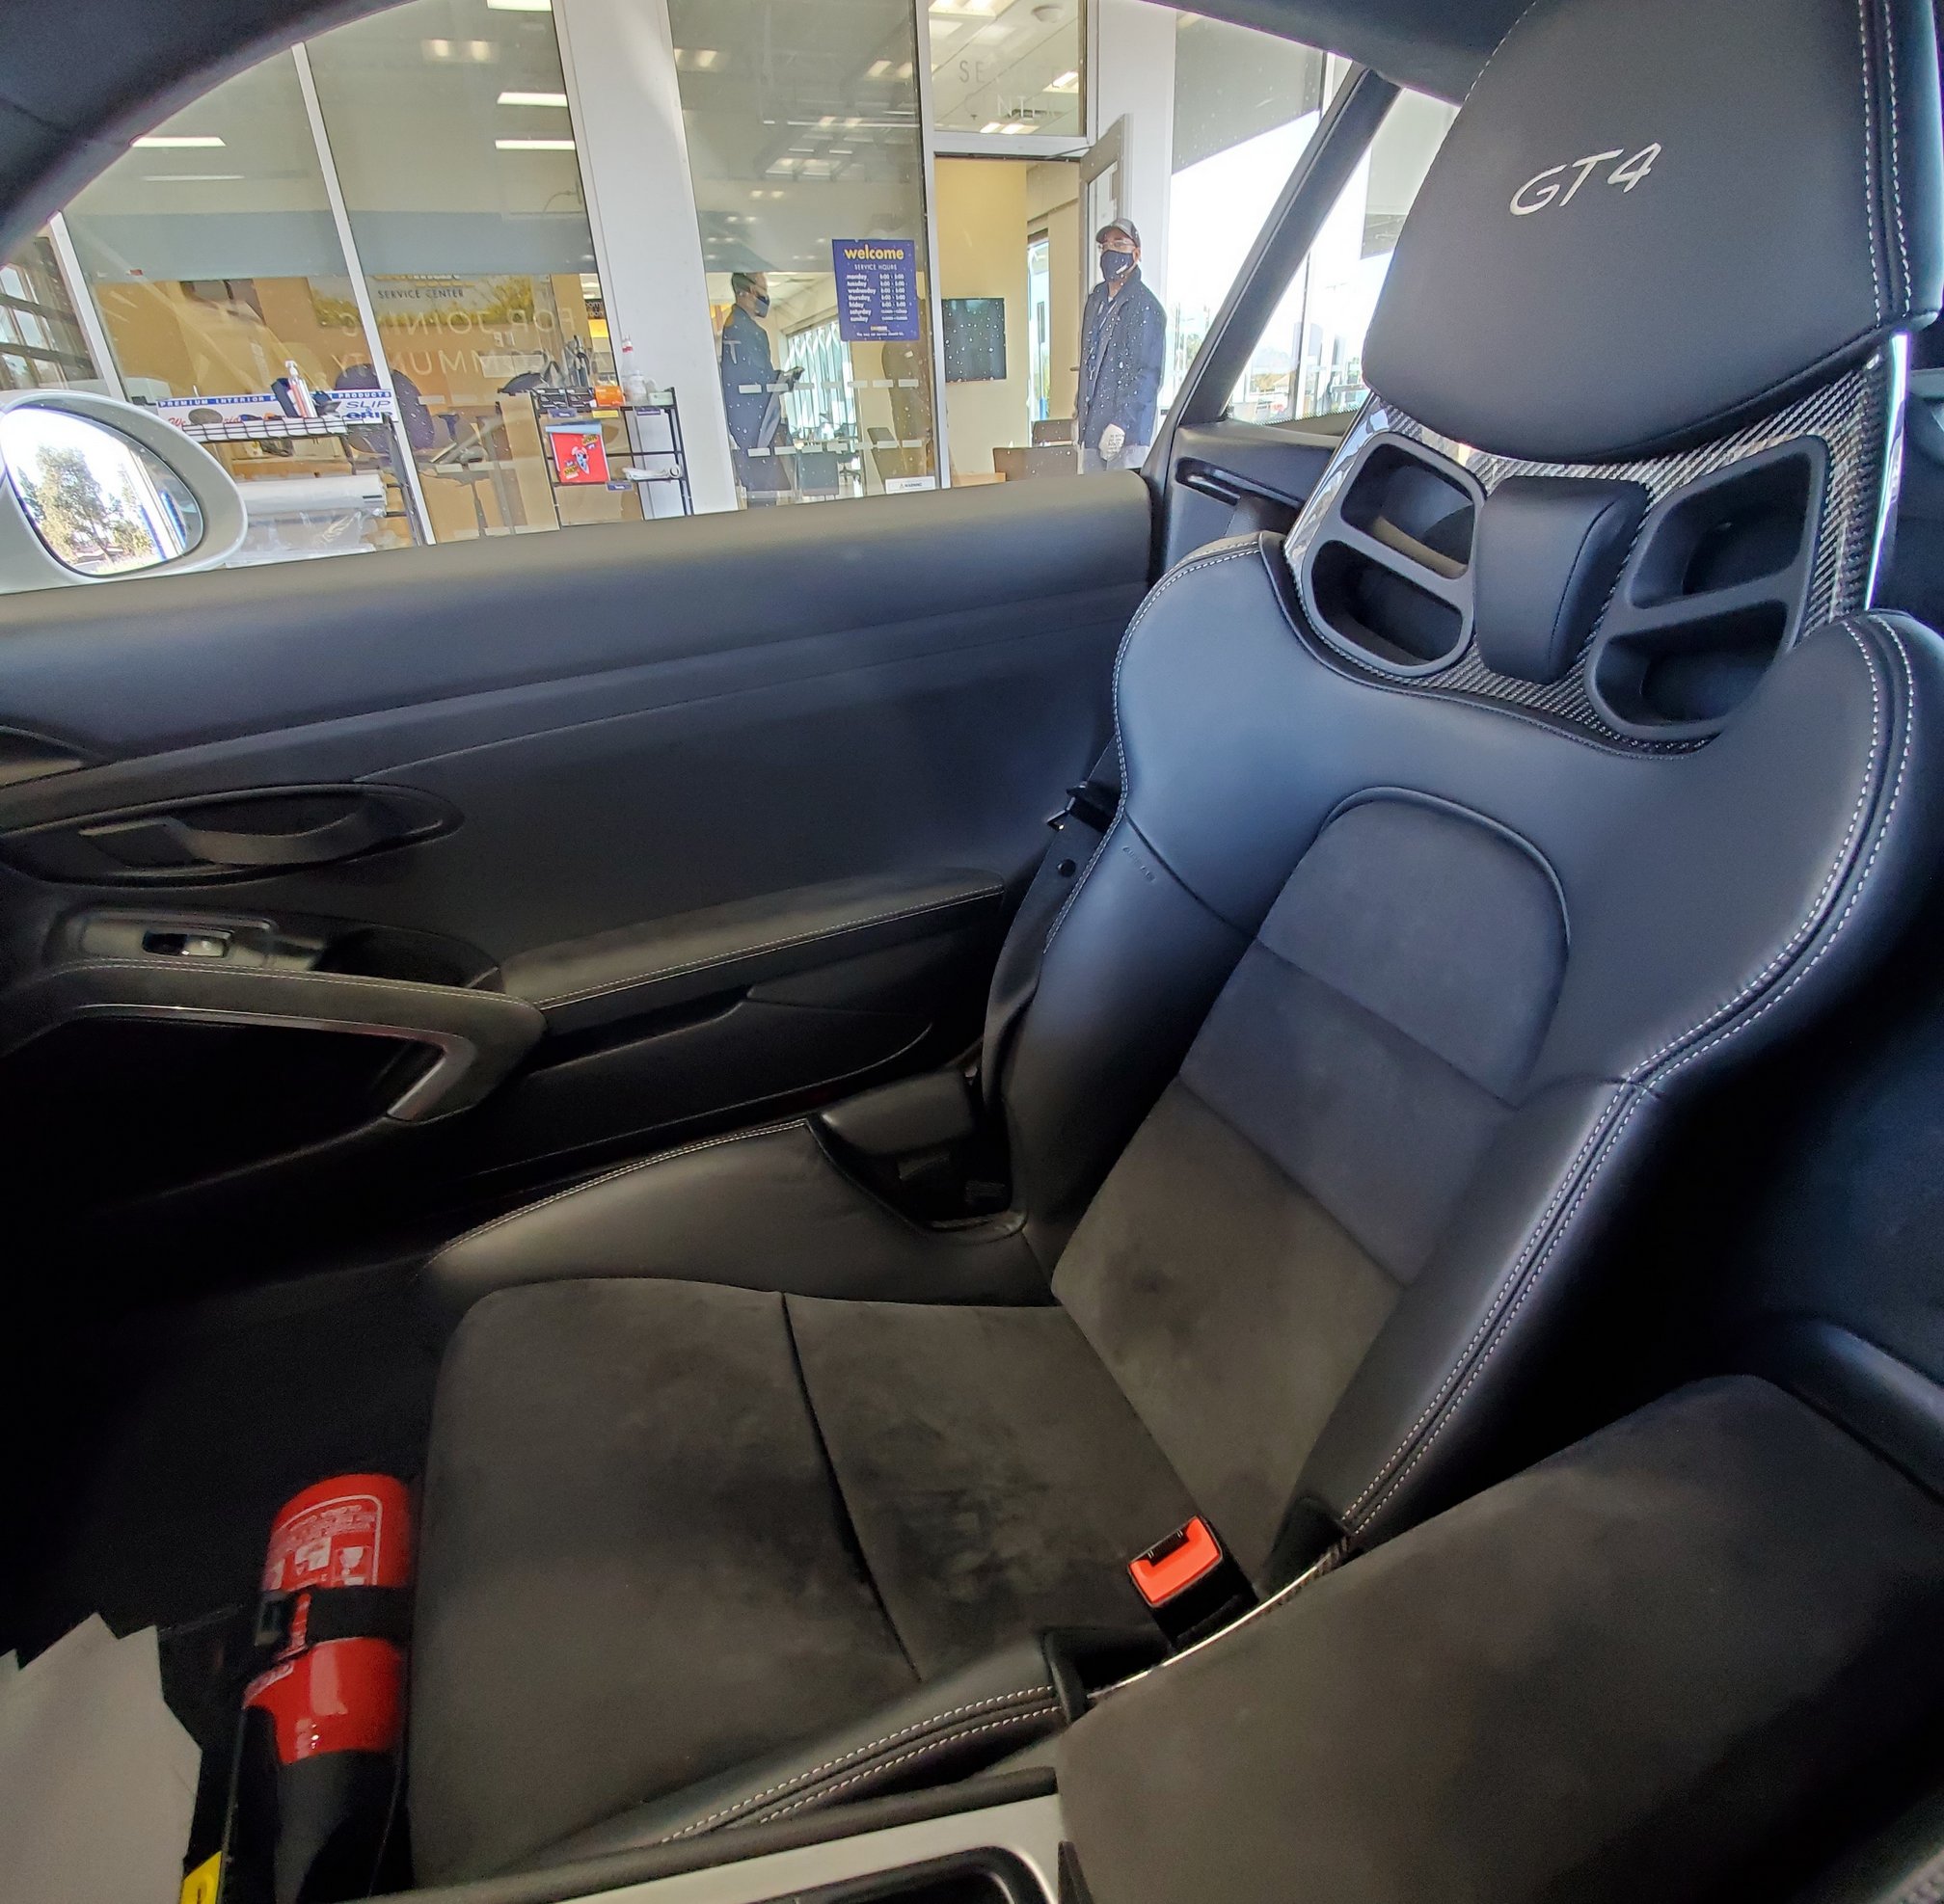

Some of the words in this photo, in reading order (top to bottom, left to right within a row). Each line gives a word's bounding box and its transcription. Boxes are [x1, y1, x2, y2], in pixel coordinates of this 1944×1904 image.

[1510, 143, 1661, 215] GT4
[844, 244, 904, 260] welcome
[377, 289, 420, 299] SERVICE
[425, 289, 464, 299] CENTER
[338, 390, 392, 399] PRODUCTS
[159, 398, 209, 408] PREMIUM
[215, 395, 265, 404] INTERIOR
[345, 400, 392, 409] SLIP
